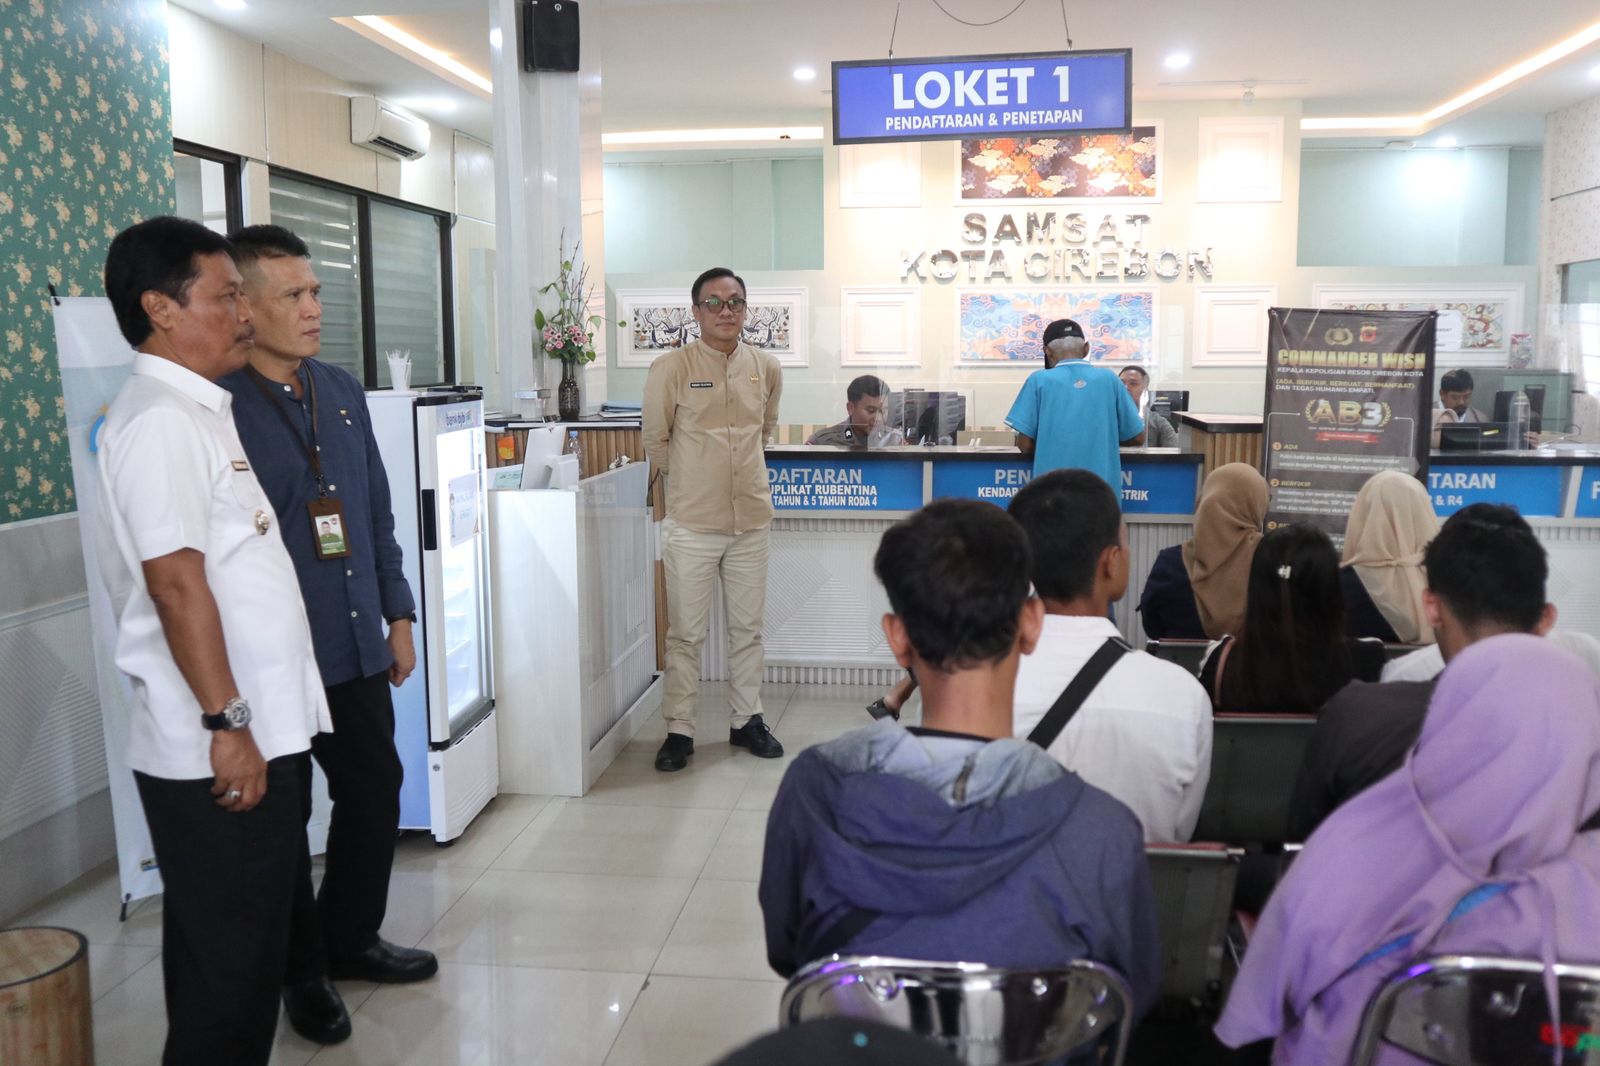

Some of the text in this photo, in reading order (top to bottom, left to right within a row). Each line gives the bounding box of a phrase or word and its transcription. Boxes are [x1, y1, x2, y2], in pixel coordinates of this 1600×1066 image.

[893, 66, 1070, 110] LOKET 1
[886, 109, 1083, 131] PENDAFTARAN & PENETAPAN
[962, 212, 1151, 246] SAMSAT
[900, 247, 1214, 281] KOTA CIREBON
[1278, 349, 1427, 369] COMMANDER WISH
[1305, 368, 1346, 376] KEPOLISIAN
[1311, 399, 1384, 427] AB3
[767, 468, 862, 484] DAFTARAN
[995, 469, 1031, 485] PEN
[1428, 473, 1496, 489] TARAN
[769, 484, 877, 495] UPLIKAT RUBENTINA
[978, 487, 1019, 498] KENDAR
[1120, 489, 1149, 501] STRIK
[773, 495, 878, 506] TAHUN & 5 TAHUN RODA 4
[1436, 495, 1445, 506] &
[1447, 495, 1463, 506] R4
